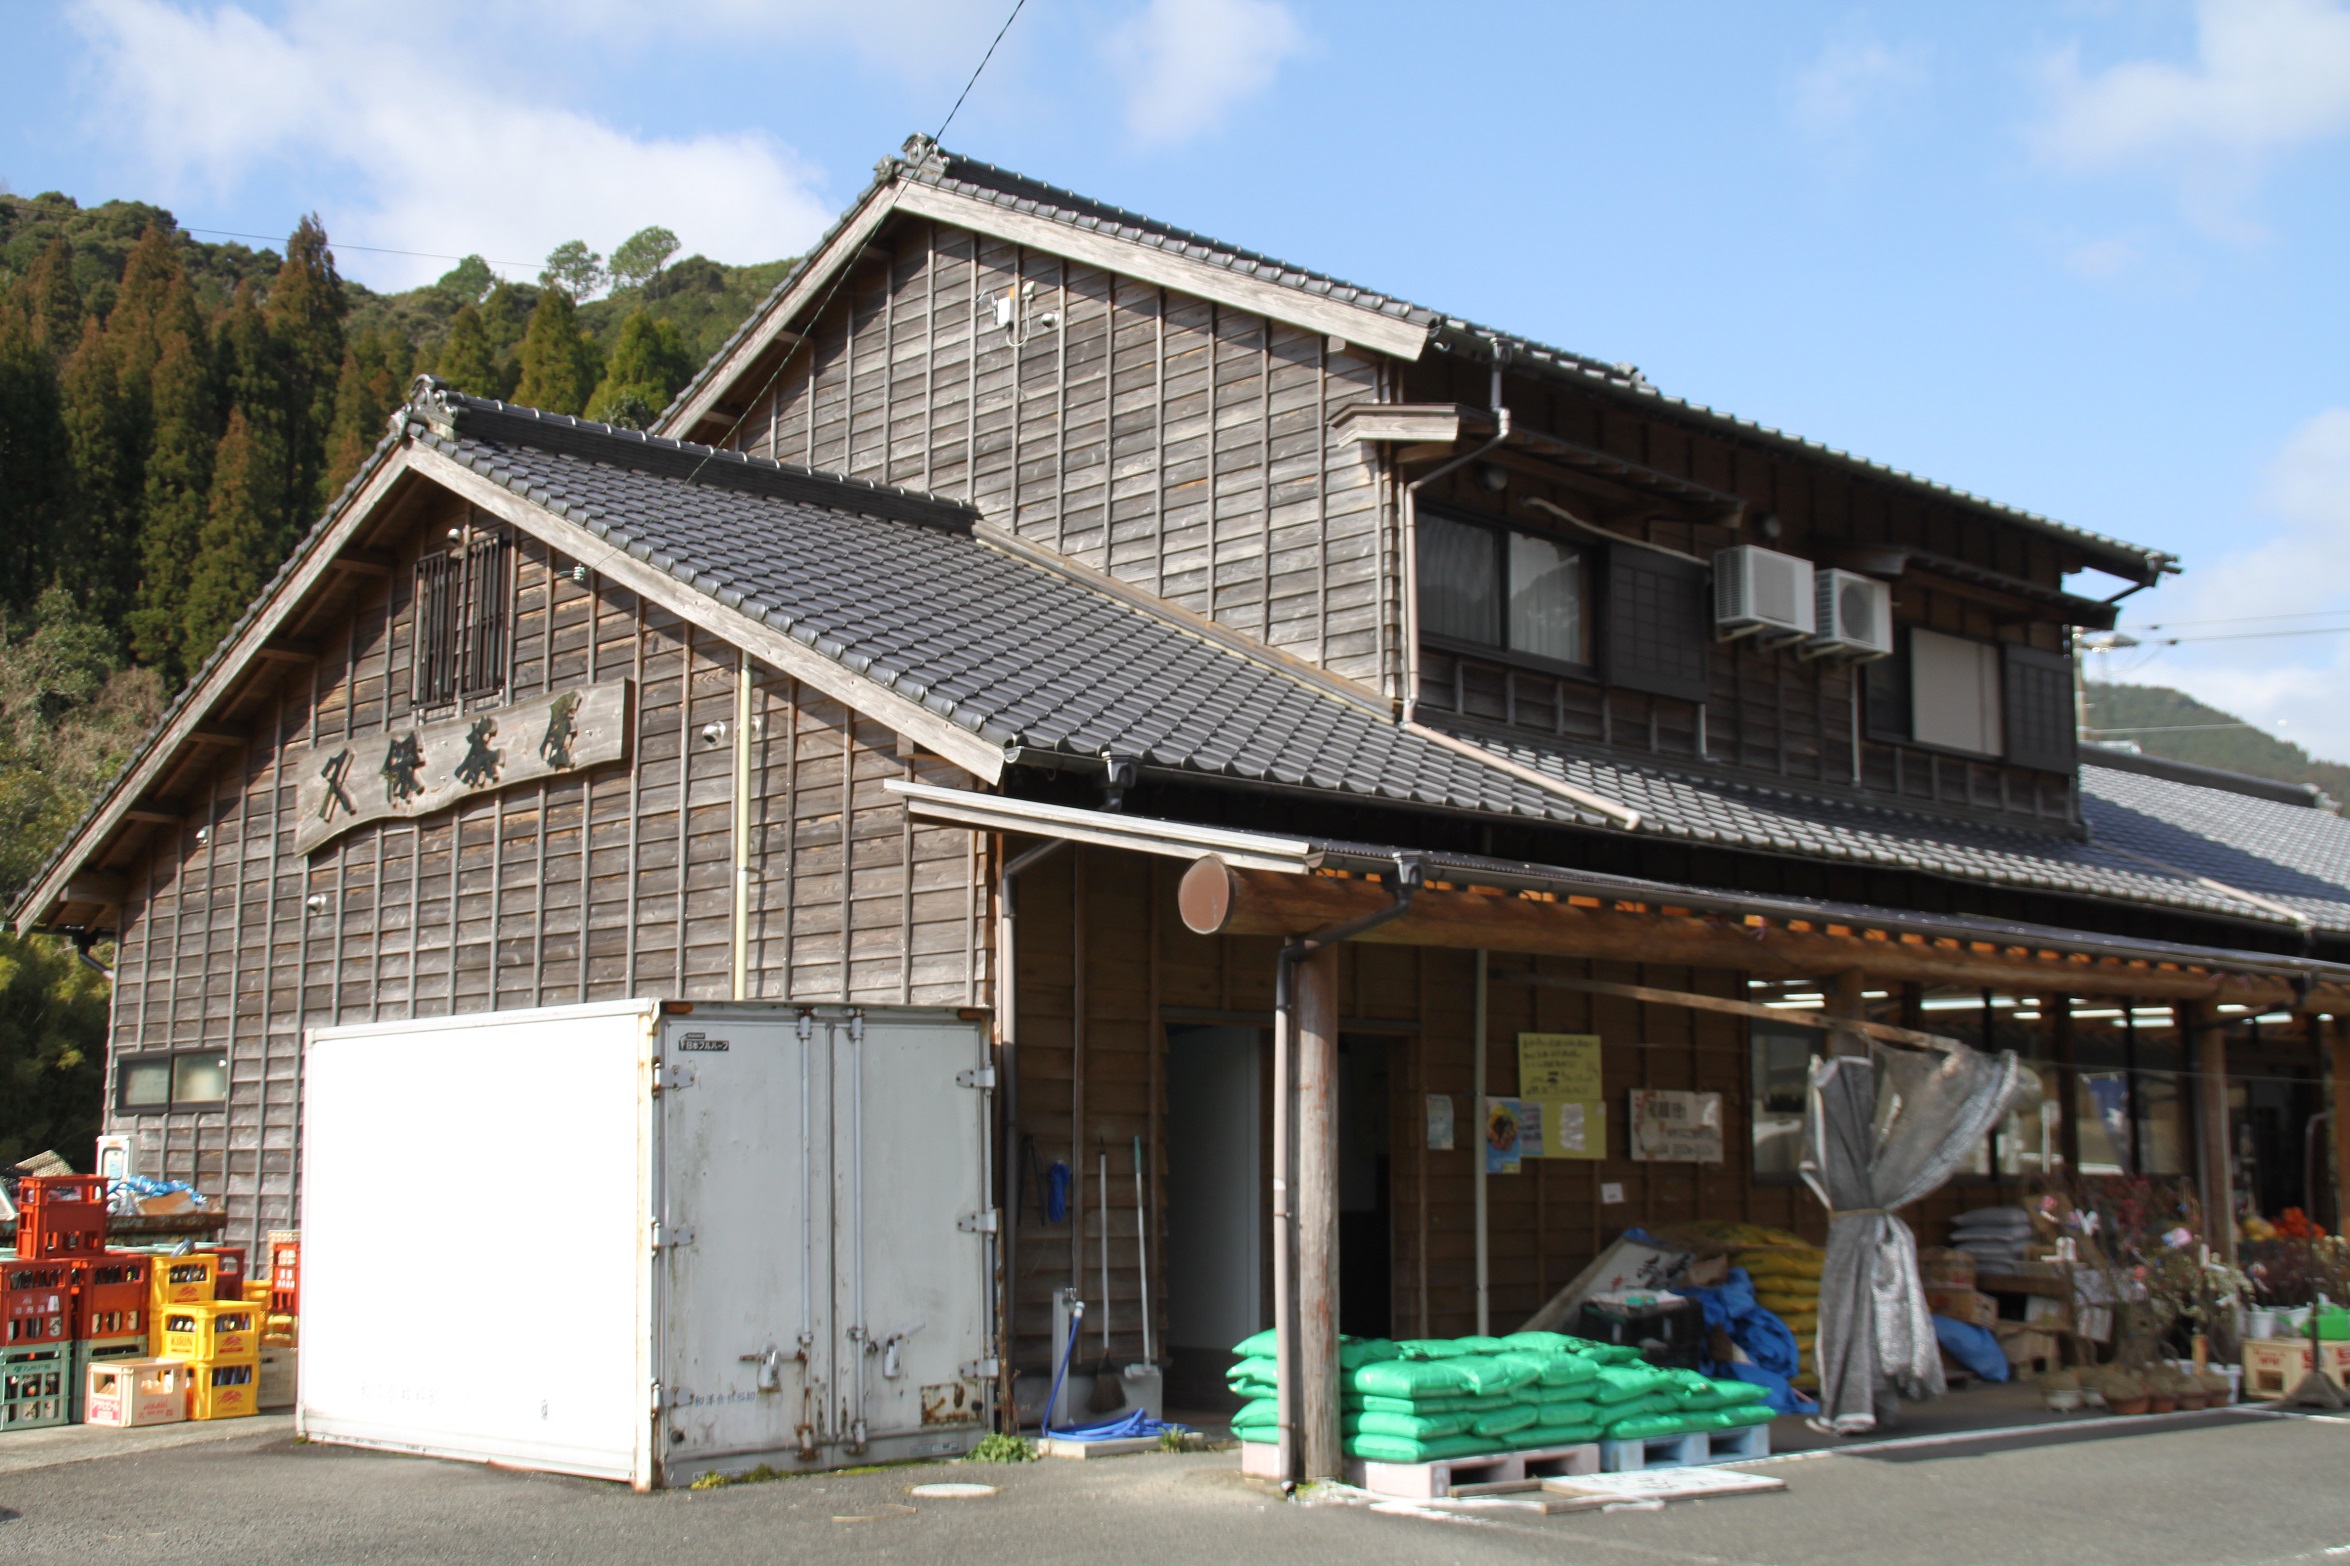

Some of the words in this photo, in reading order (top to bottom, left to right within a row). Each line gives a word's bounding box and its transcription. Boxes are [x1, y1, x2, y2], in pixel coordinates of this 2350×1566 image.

[686, 1041, 729, 1050] 日本フルハーフ
[170, 1335, 193, 1347] KIRIN
